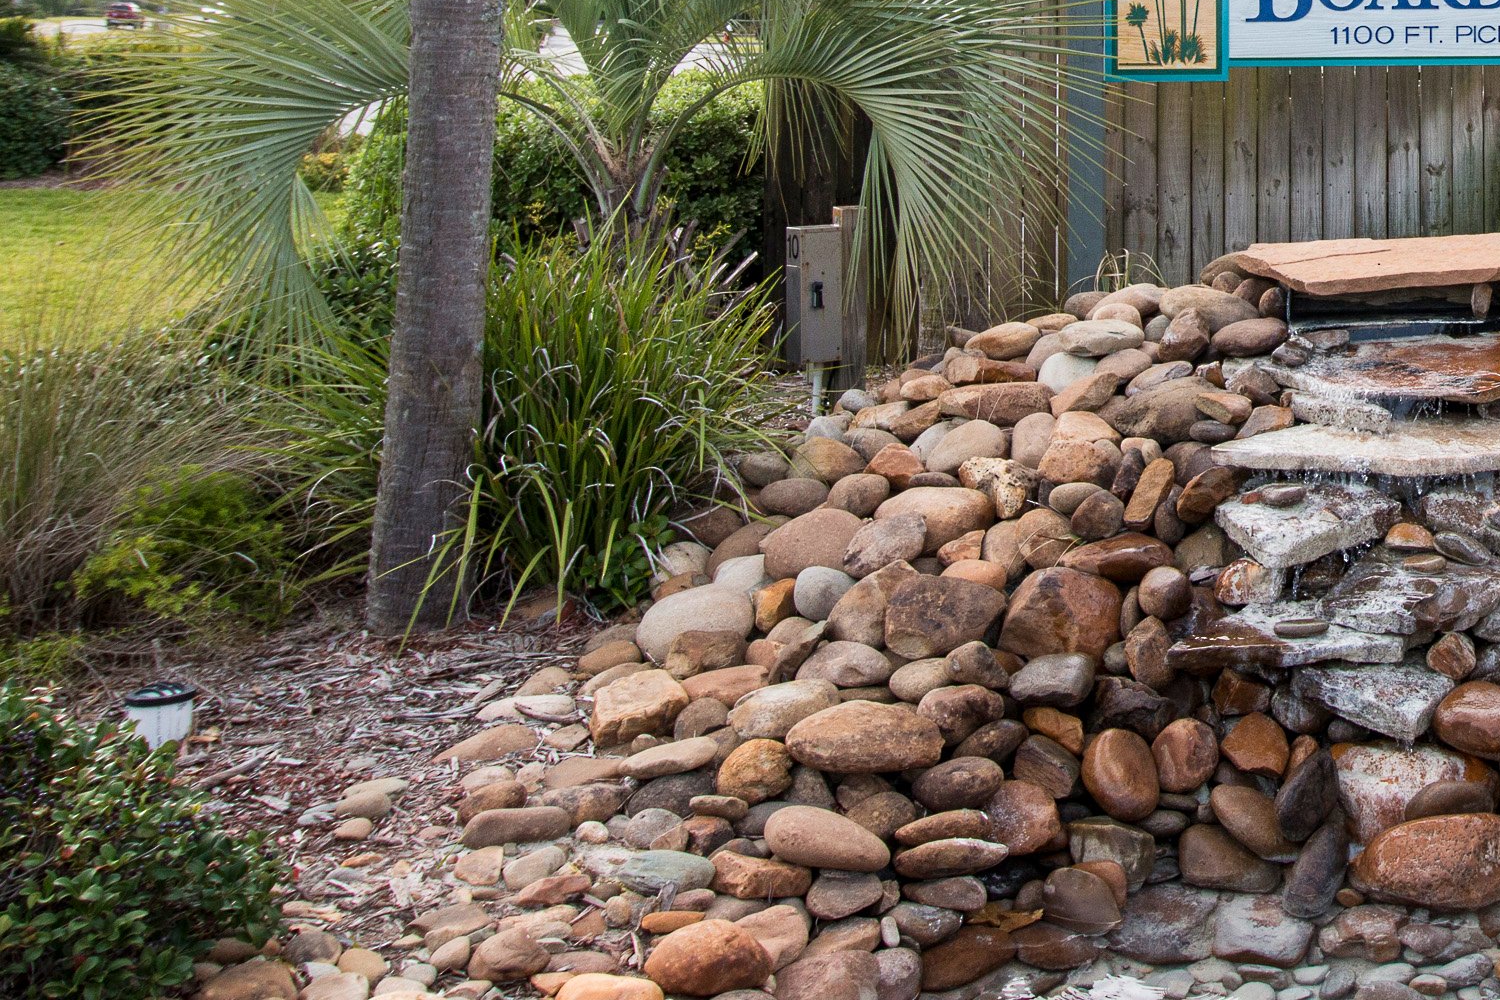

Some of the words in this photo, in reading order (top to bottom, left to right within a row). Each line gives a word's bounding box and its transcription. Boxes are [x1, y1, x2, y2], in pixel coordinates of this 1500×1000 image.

[1330, 25, 1395, 45] 1100
[1405, 25, 1443, 44] FT.
[787, 234, 799, 260] 10
